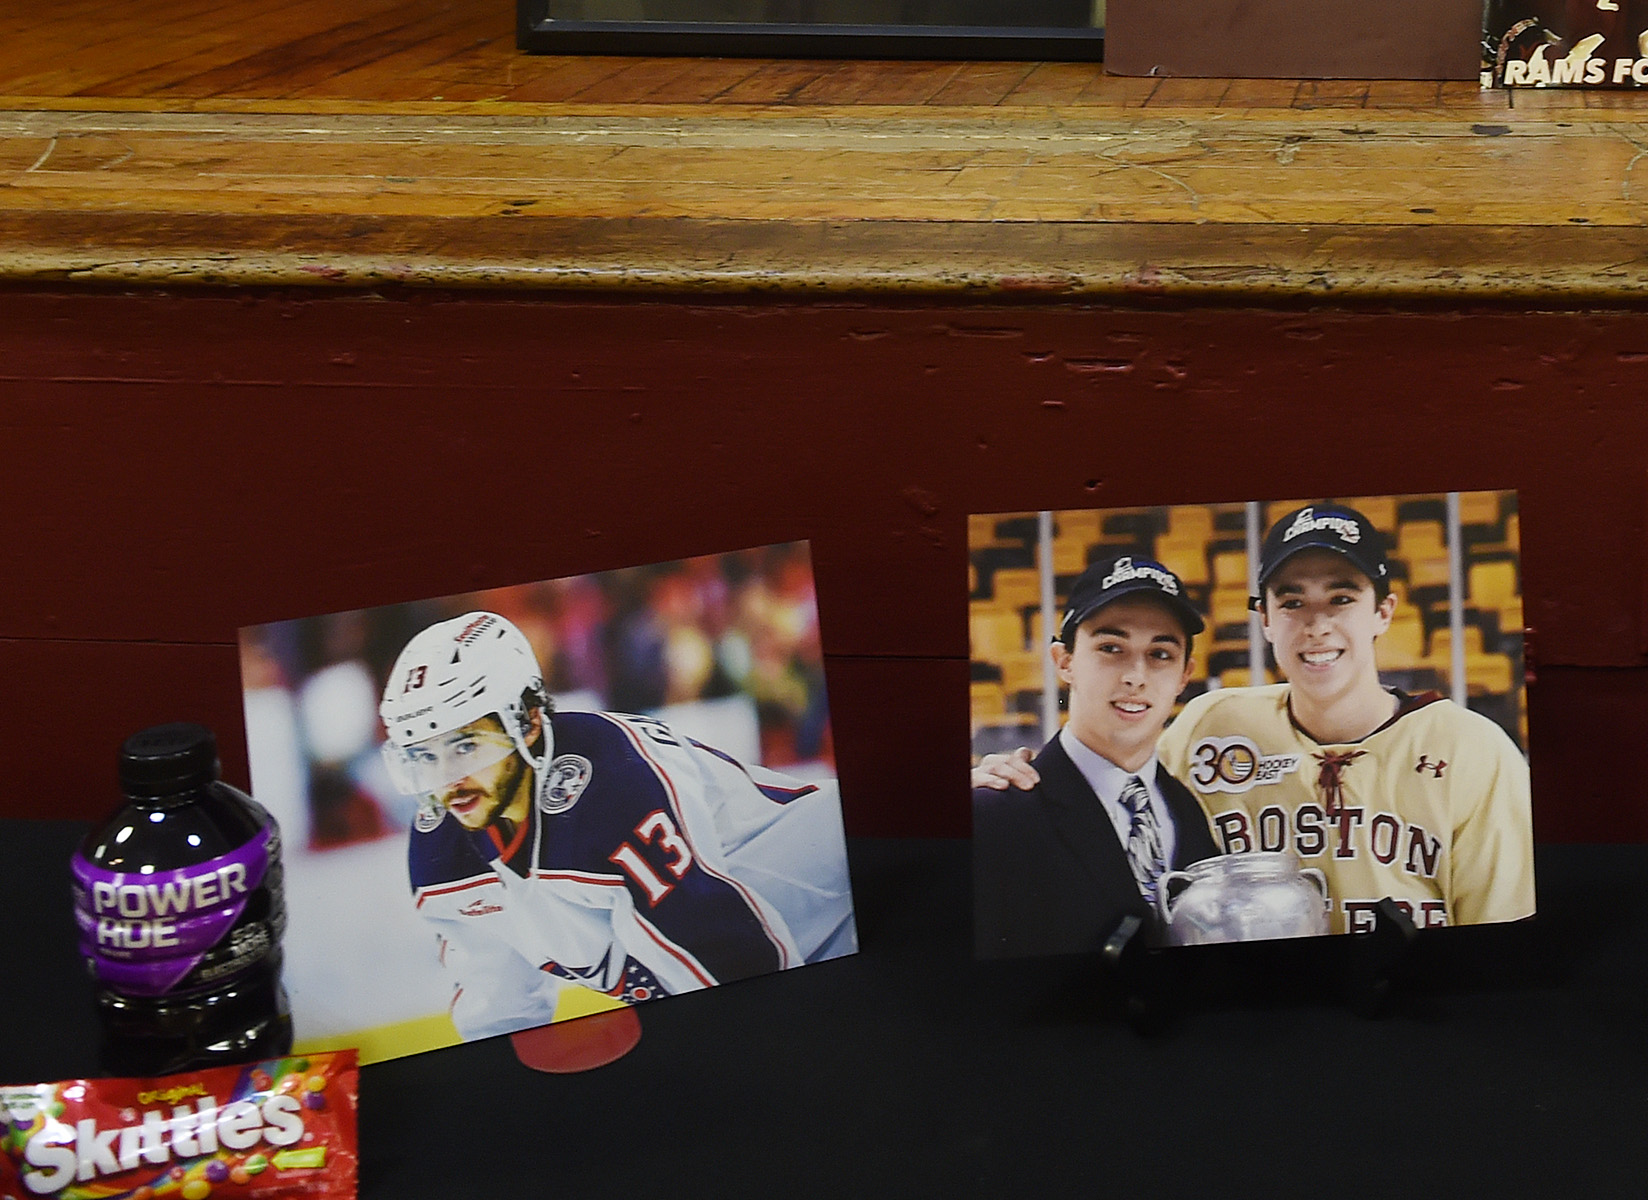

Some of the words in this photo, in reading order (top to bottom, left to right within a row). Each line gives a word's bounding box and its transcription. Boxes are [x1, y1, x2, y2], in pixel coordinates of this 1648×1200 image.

[1503, 58, 1606, 85] RAMS
[1194, 743, 1256, 785] 30
[1255, 767, 1283, 782] EAST
[1256, 757, 1298, 771] HOCKEY
[608, 808, 694, 909] 13
[1213, 803, 1443, 879] BOSTON
[93, 862, 248, 918] POWER
[23, 1095, 305, 1194] Skittles
